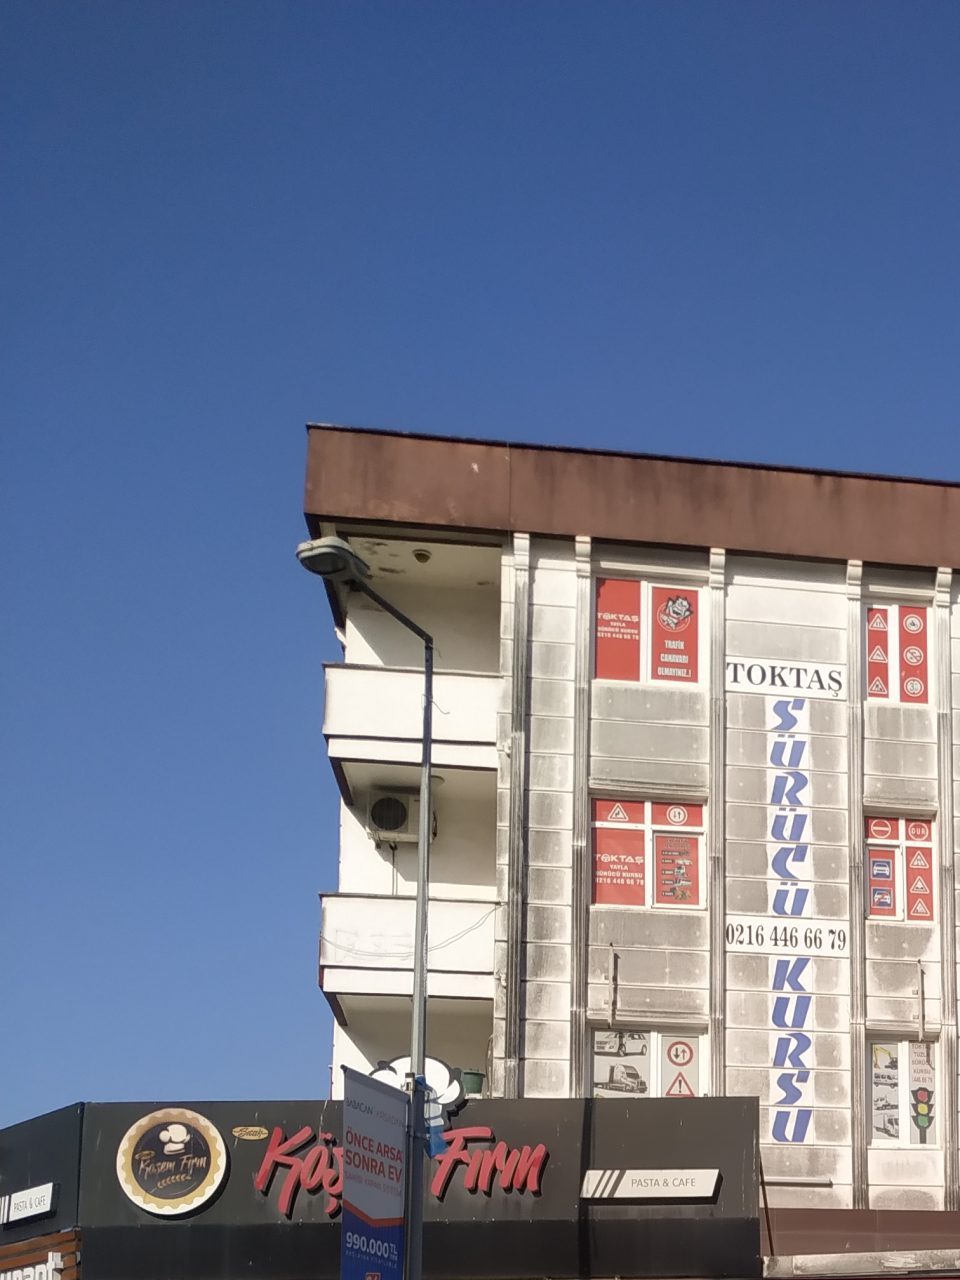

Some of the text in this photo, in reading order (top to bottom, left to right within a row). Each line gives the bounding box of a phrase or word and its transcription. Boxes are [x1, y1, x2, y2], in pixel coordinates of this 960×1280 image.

[726, 662, 843, 697] TOKTAŞ
[769, 698, 809, 916] SÜRÜCÜ
[911, 827, 925, 835] DUR
[595, 853, 644, 865] TOKTAŞ
[726, 923, 847, 951] 0216 446 66 79
[772, 957, 813, 1143] KURSU
[345, 1126, 403, 1163] ÖNCE ARSA
[256, 1126, 343, 1214] Köş
[345, 1150, 386, 1178] SONRA
[388, 1165, 403, 1184] EV
[631, 1177, 696, 1188] PASTA & CAFE
[13, 1196, 28, 1213] PASTA
[345, 1231, 389, 1258] 990.000
